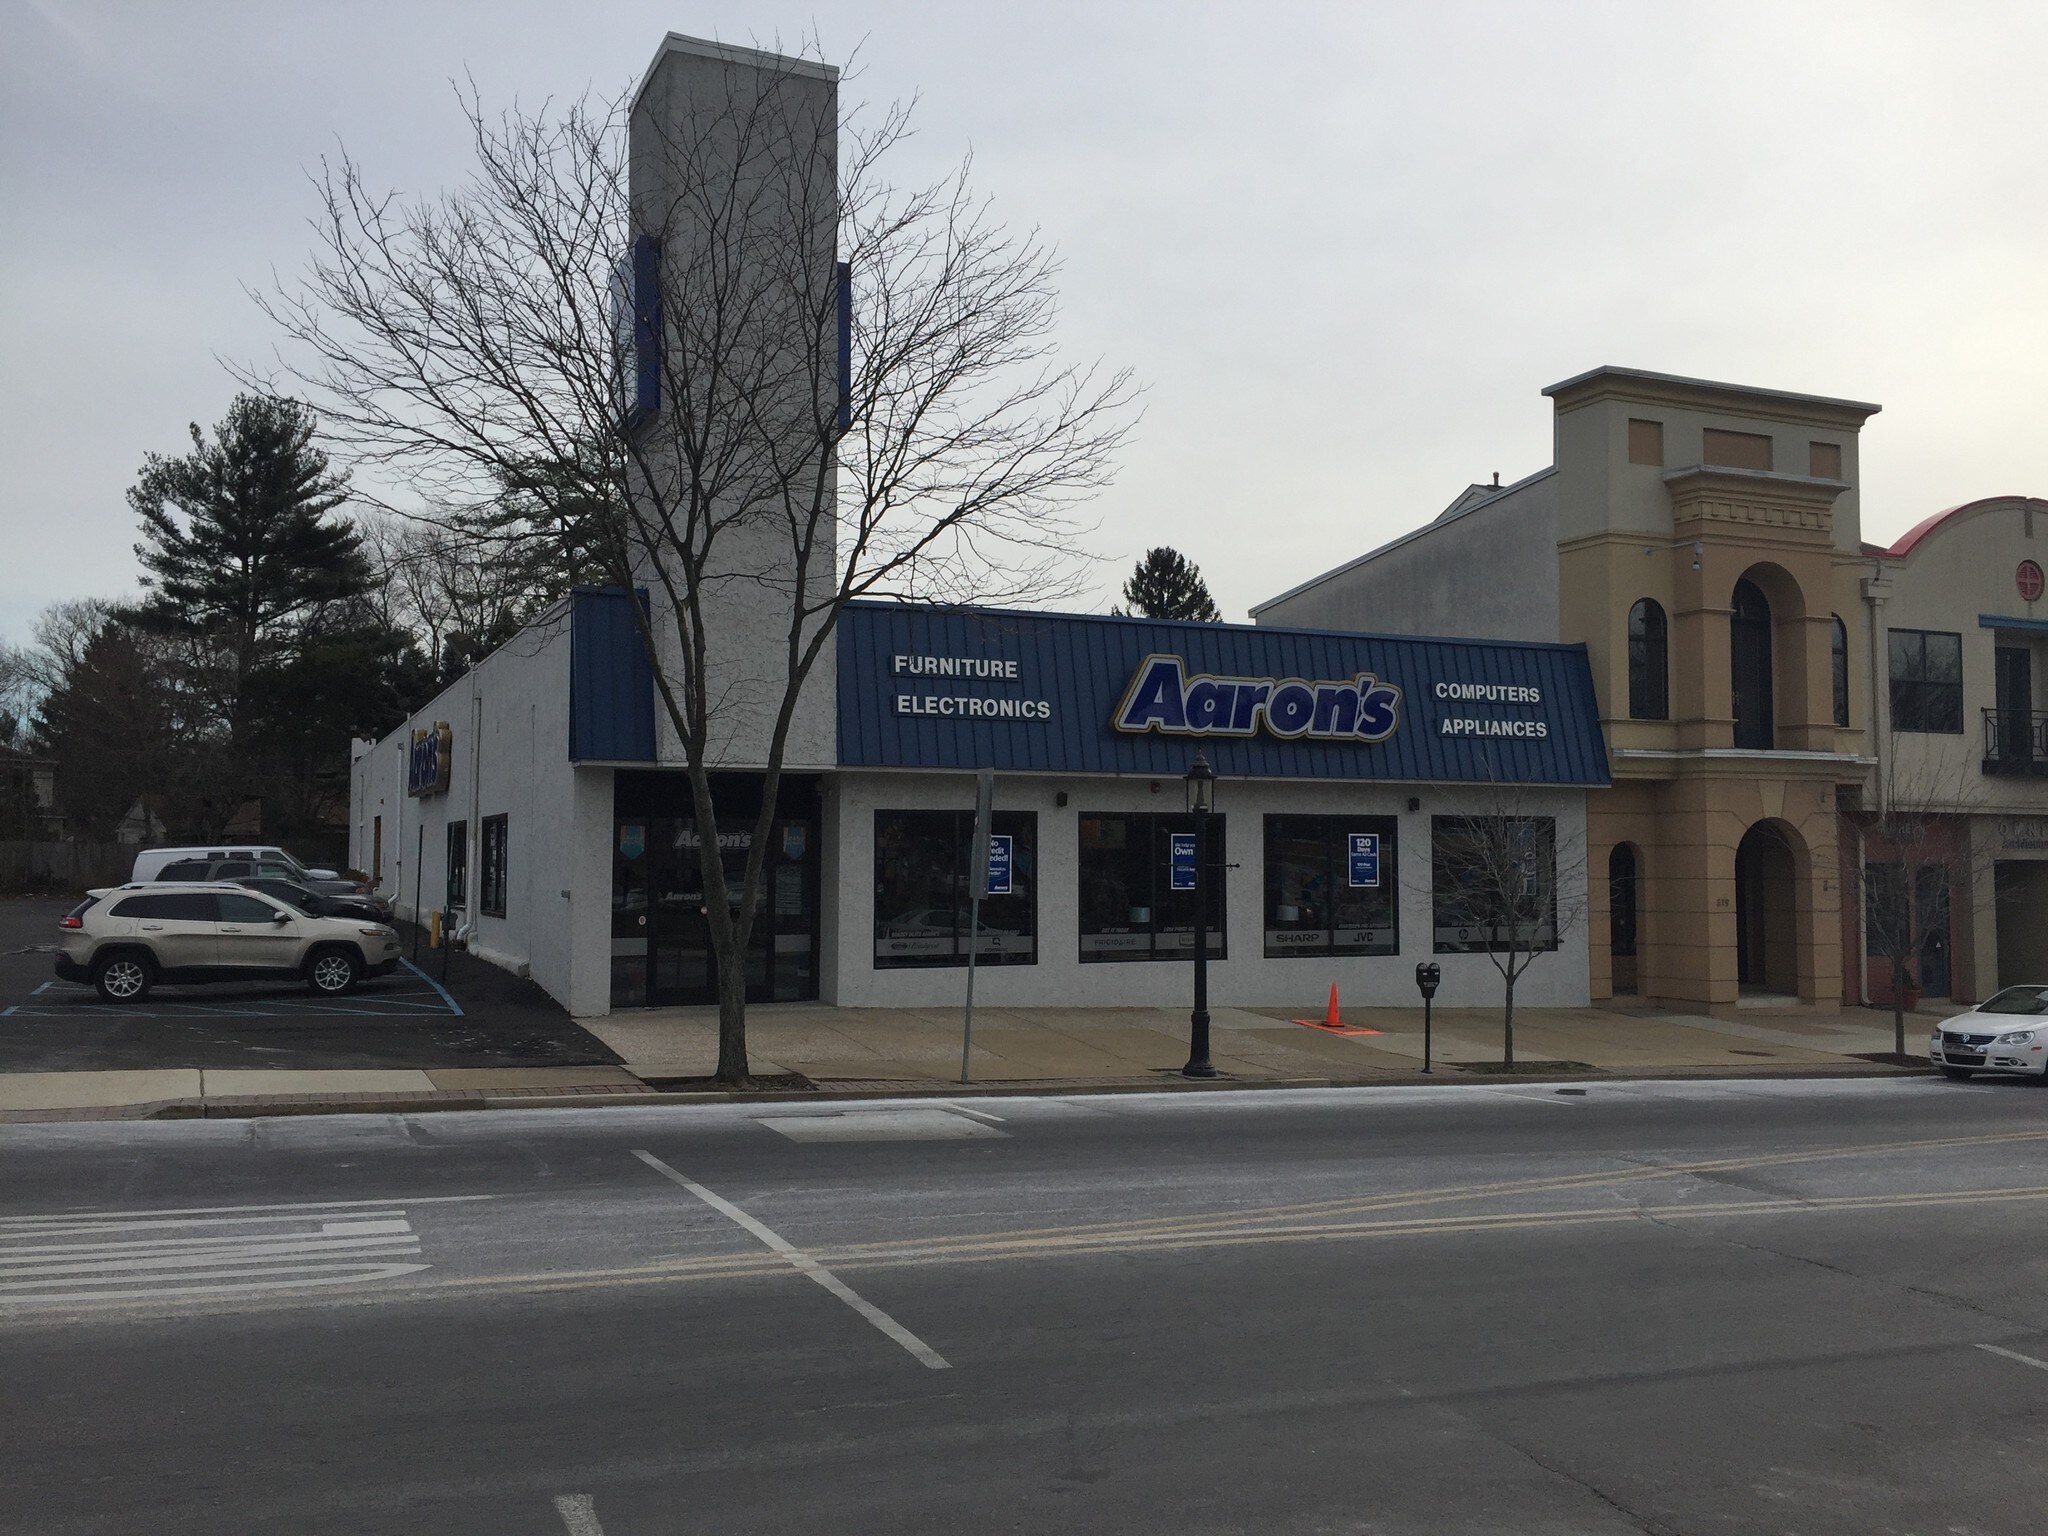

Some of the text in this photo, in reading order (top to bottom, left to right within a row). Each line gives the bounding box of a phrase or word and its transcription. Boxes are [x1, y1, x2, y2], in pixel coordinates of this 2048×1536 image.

[894, 655, 1018, 678] FURNITURE
[1118, 656, 1401, 739] Aaron's
[1435, 682, 1540, 703] COMPUTERS
[897, 695, 1051, 719] ELECTRONICS
[1441, 718, 1547, 738] APPLIANCES
[673, 829, 752, 848] Aaon's
[1356, 838, 1371, 847] 120
[1175, 847, 1193, 855] Own
[1095, 938, 1137, 946] FRIGIDAIRE
[1276, 933, 1320, 943] SHARP
[1353, 932, 1373, 942] JVC
